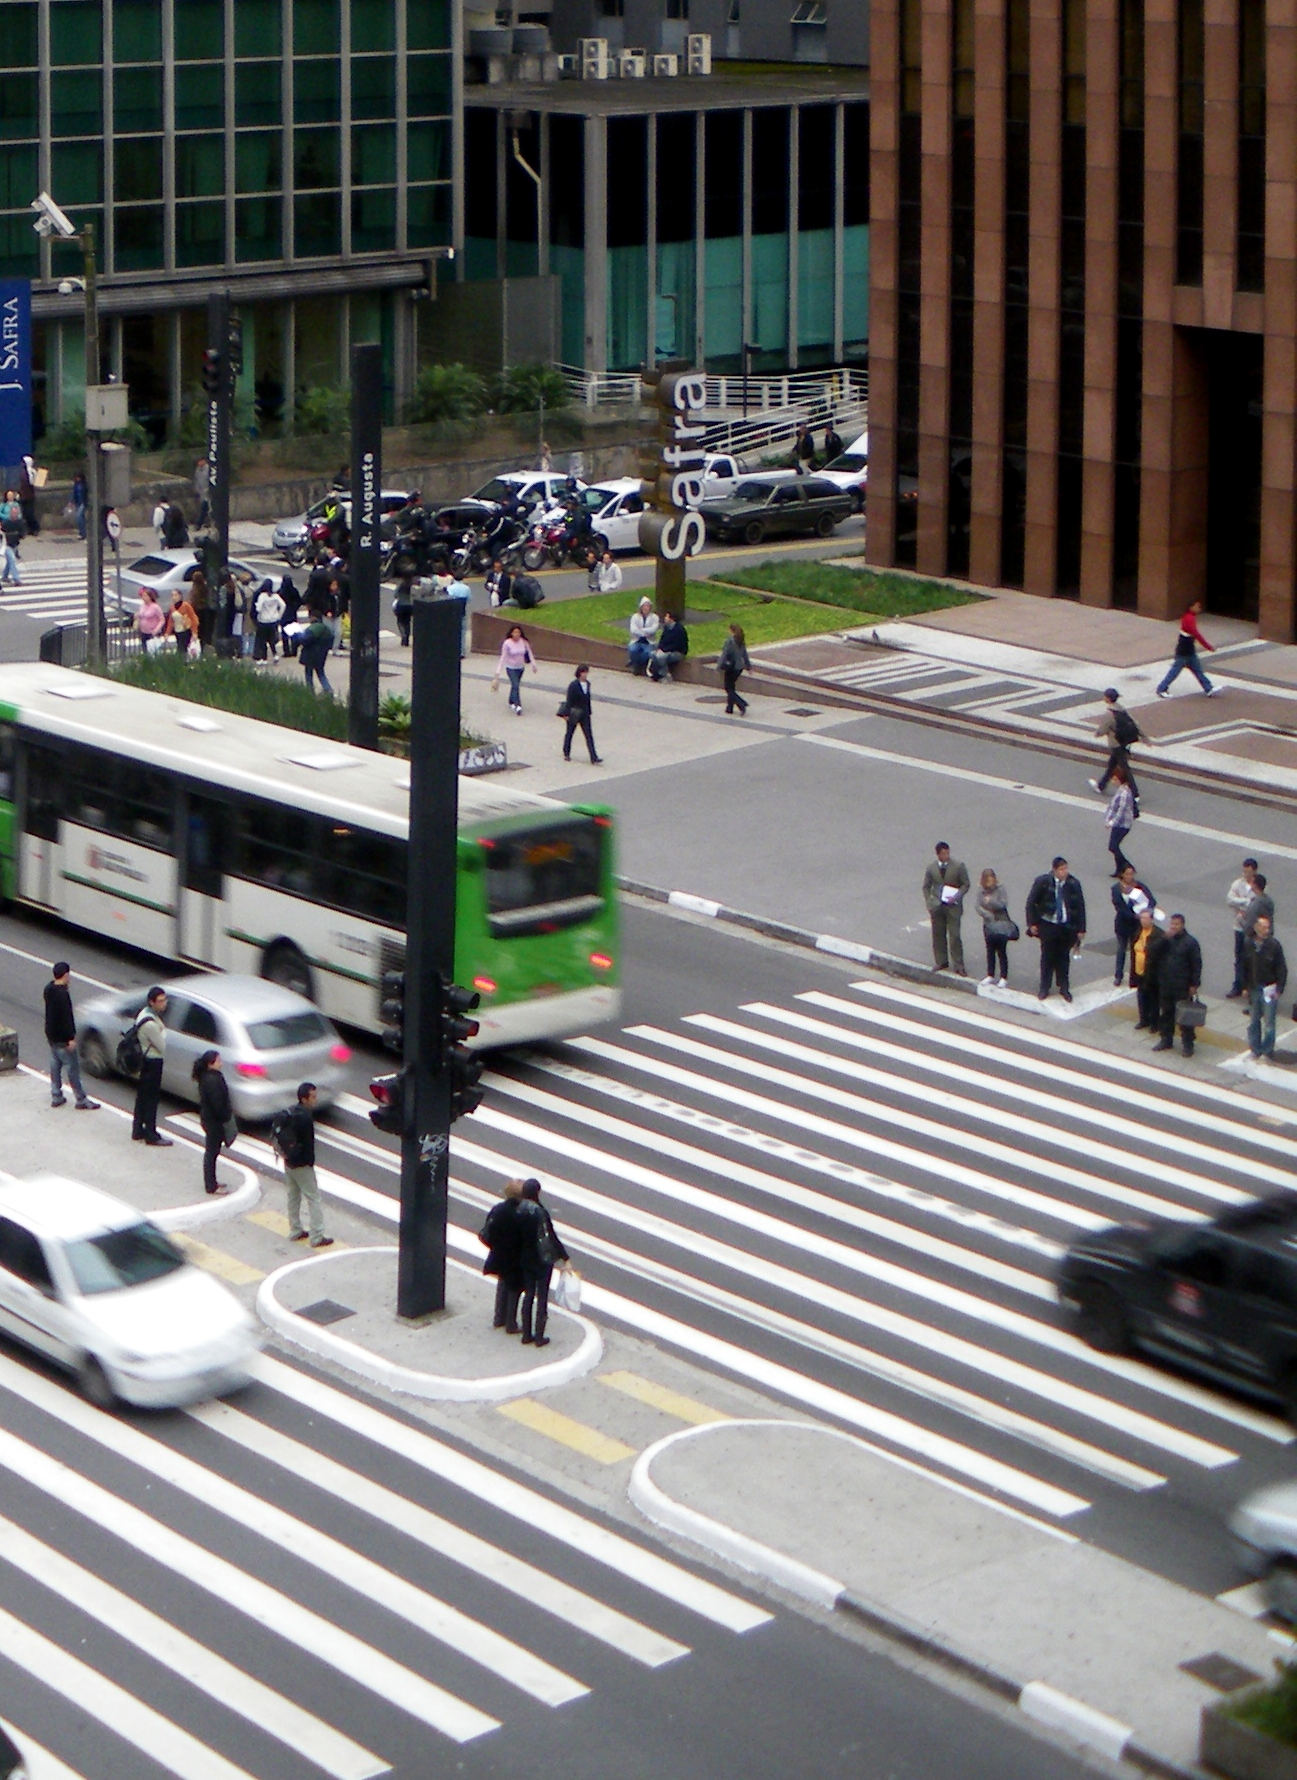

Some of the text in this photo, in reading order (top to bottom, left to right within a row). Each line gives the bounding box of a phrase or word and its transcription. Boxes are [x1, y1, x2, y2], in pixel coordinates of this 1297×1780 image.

[208, 400, 218, 462] Paulista
[660, 372, 708, 561] Safra
[360, 452, 377, 548] R. Augusta
